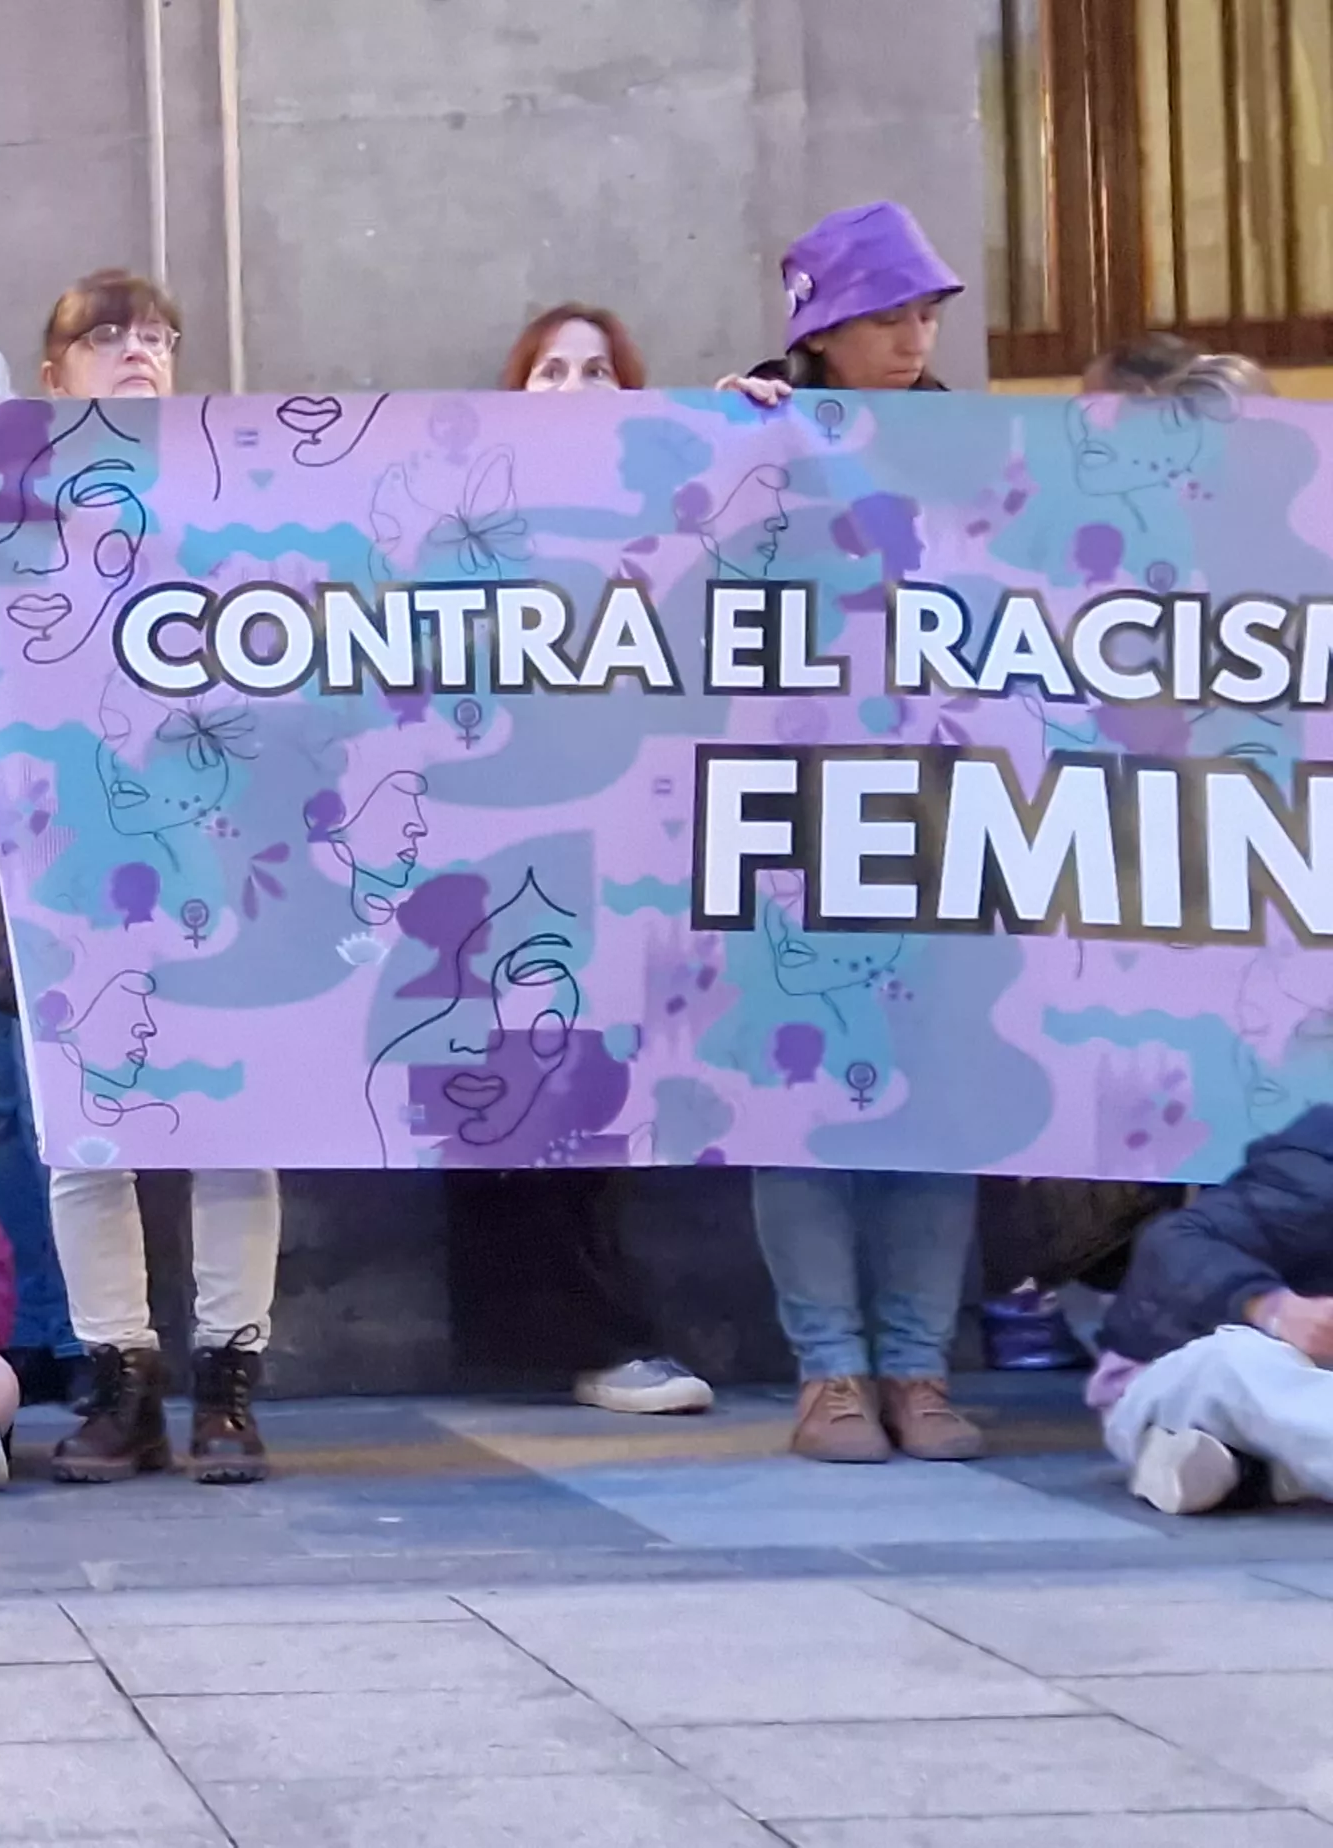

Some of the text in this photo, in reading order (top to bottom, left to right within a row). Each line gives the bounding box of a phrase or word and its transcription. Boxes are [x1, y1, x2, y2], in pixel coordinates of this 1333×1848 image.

[116, 584, 679, 692] CONTRA
[707, 583, 846, 691] EL
[698, 751, 1333, 938] FEMIN
